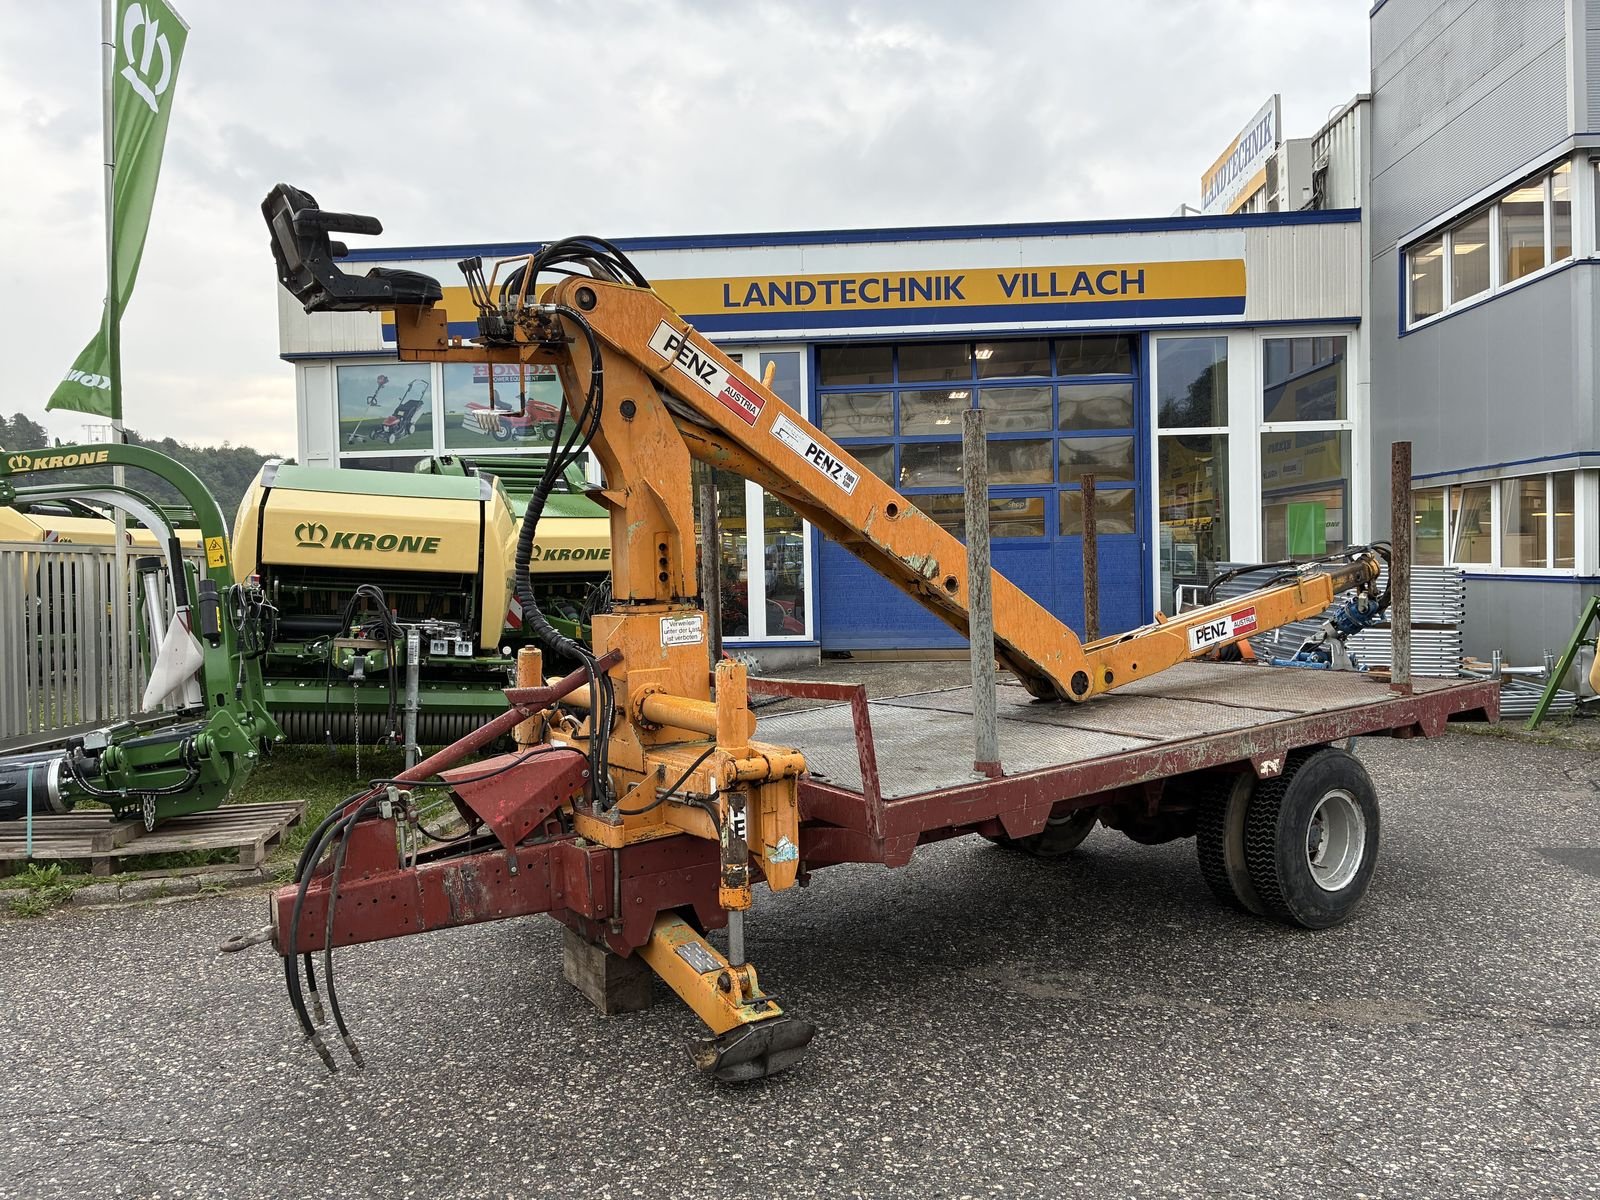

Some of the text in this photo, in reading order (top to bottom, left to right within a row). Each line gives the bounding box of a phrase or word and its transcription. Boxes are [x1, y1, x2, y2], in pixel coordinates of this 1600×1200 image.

[1203, 110, 1273, 210] LANDTECHNIK
[723, 269, 1145, 308] LANDTECHNIK VILLACH
[663, 333, 718, 386] PENZ
[724, 386, 756, 415] AUSTRIA
[33, 450, 109, 470] KRONE
[805, 442, 844, 480] PENZ
[330, 532, 441, 554] KRONE
[543, 548, 611, 561] KRONE
[1196, 621, 1227, 645] PENZ
[1234, 616, 1255, 628] AUSTRIA
